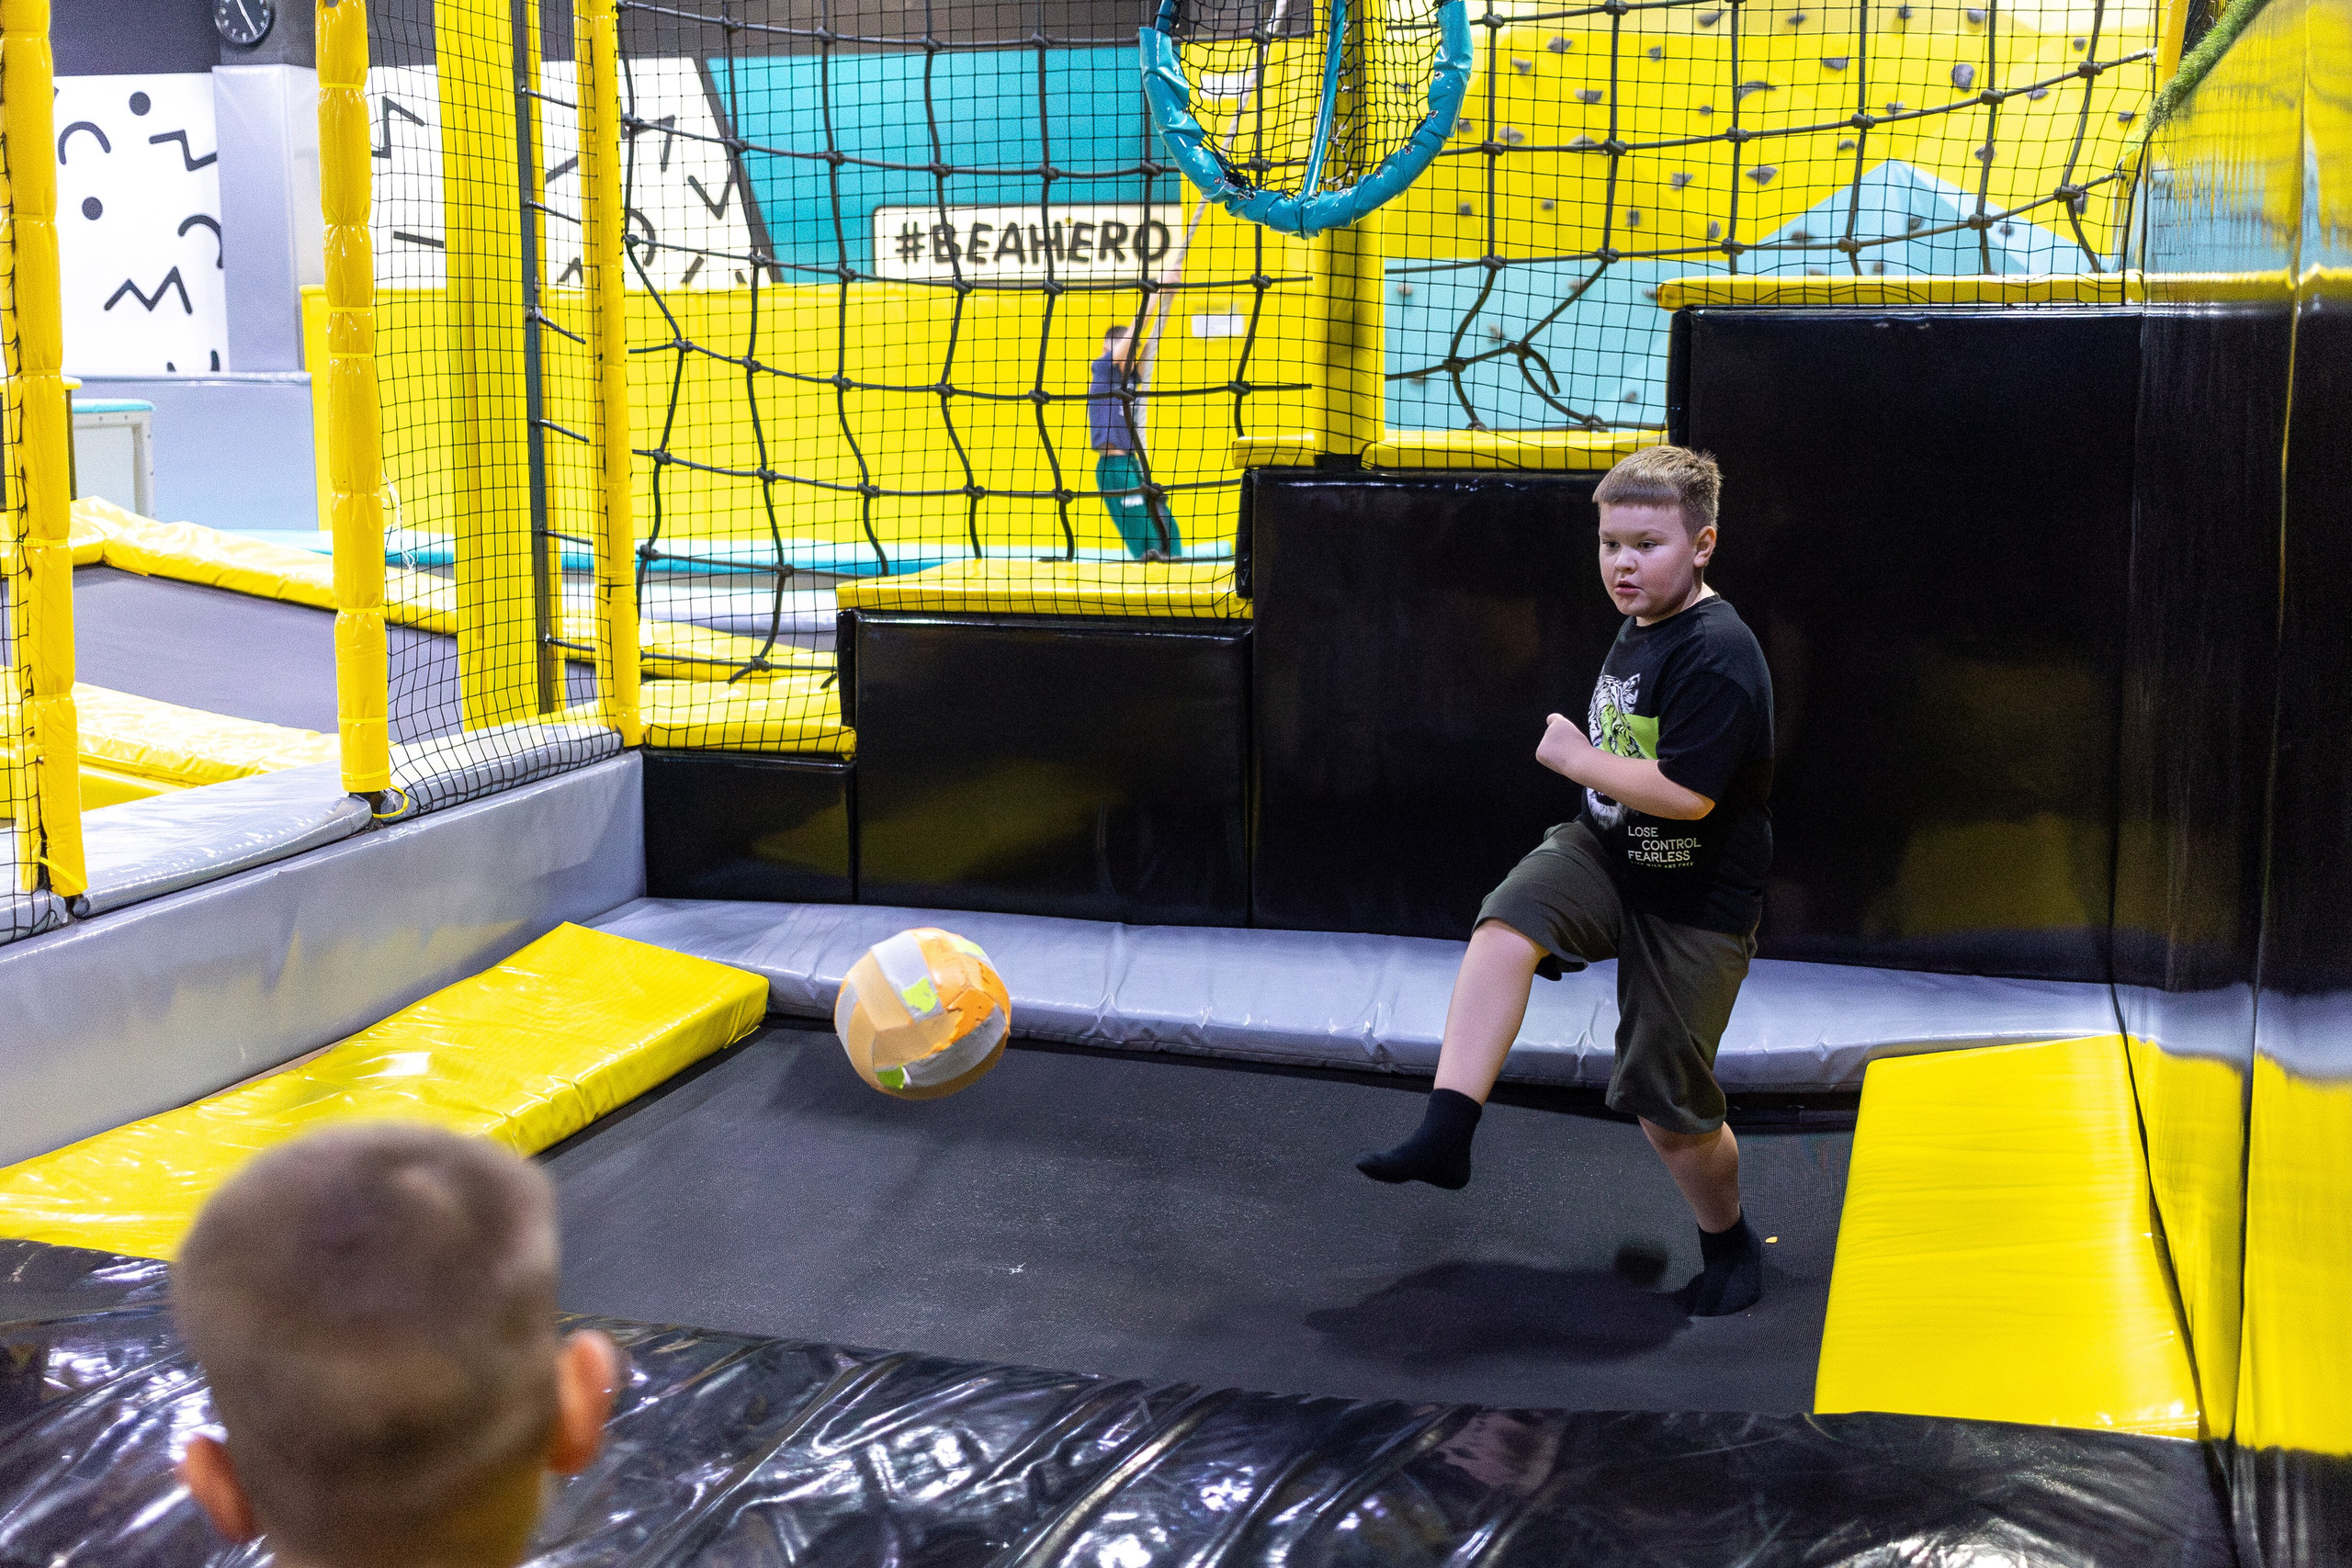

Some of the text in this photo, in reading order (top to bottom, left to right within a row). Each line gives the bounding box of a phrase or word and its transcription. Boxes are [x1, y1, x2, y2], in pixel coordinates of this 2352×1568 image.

[895, 220, 1170, 265] #BEAHERO
[1628, 826, 1658, 837] LOSE
[1642, 838, 1702, 851] CONTROL
[1628, 851, 1690, 862] FEARLESS
